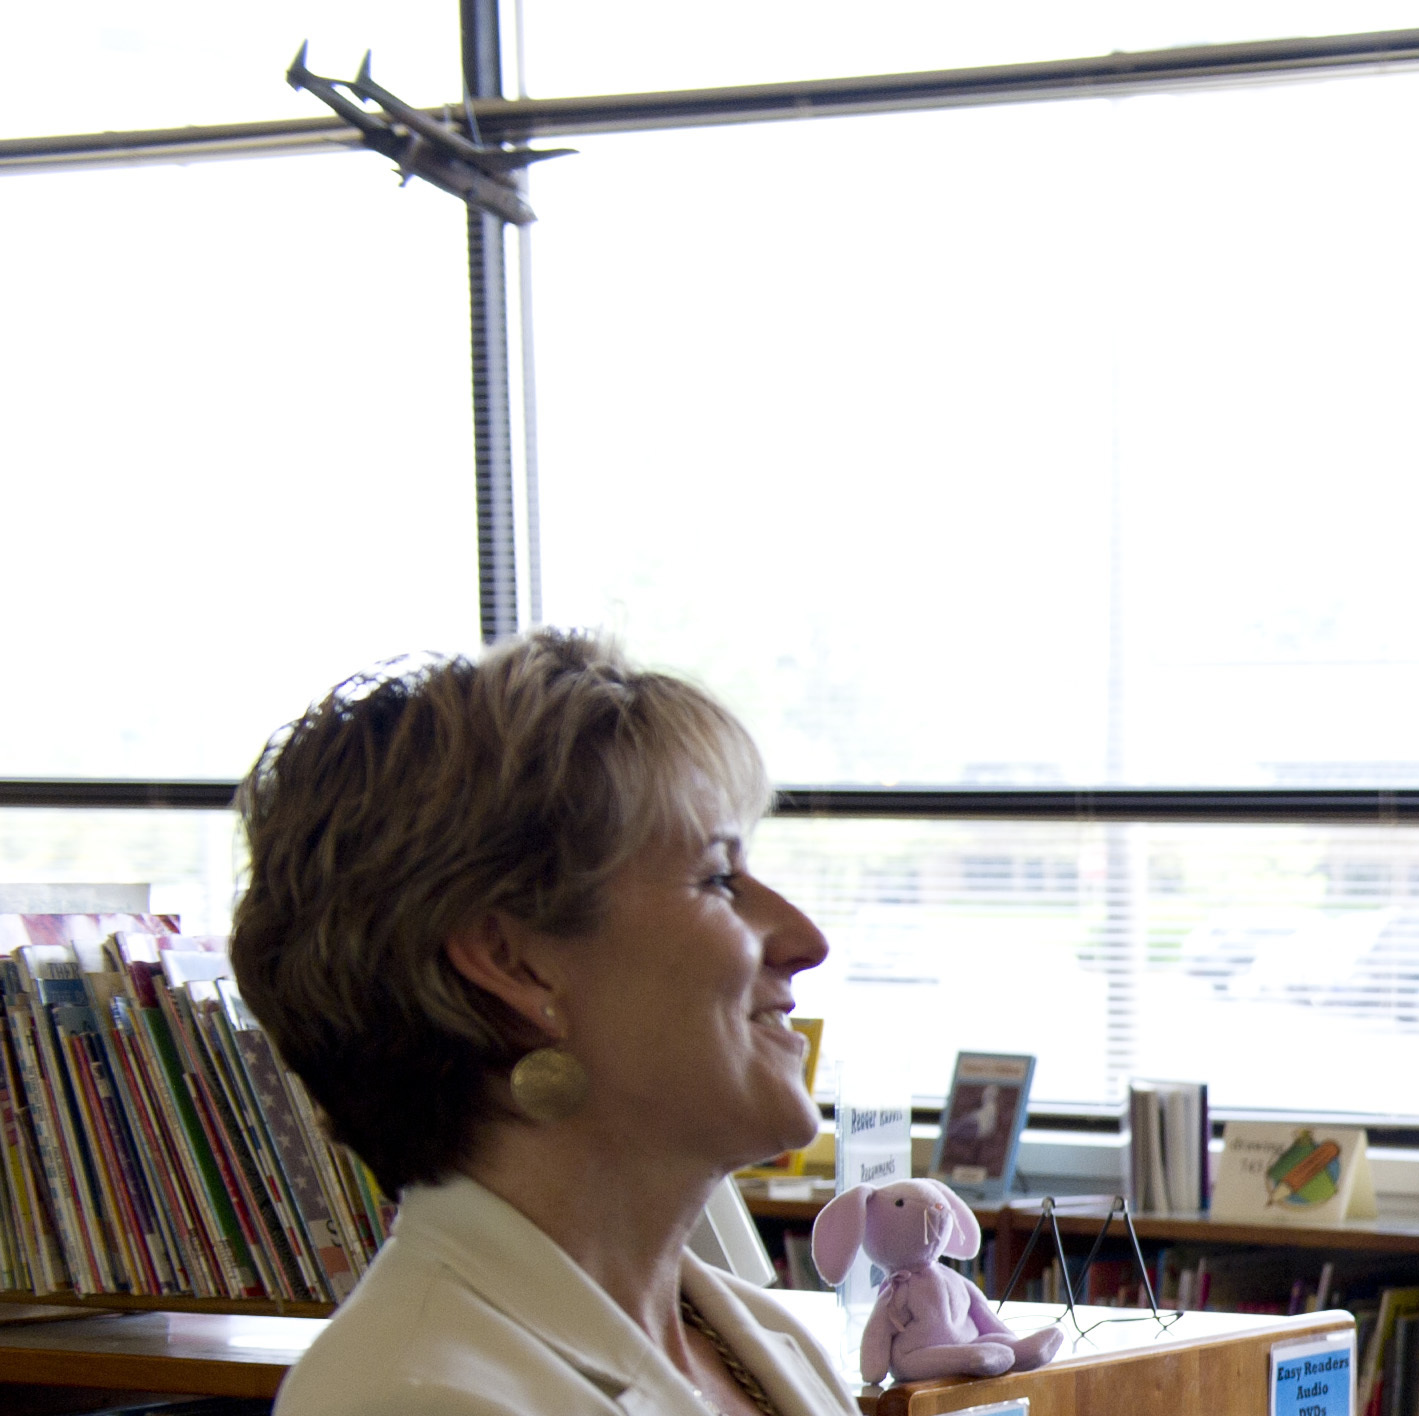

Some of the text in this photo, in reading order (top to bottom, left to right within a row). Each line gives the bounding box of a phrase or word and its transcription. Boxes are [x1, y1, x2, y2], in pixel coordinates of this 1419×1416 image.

[1277, 1356, 1350, 1382] Easy Readers
[1296, 1381, 1329, 1400] Audio
